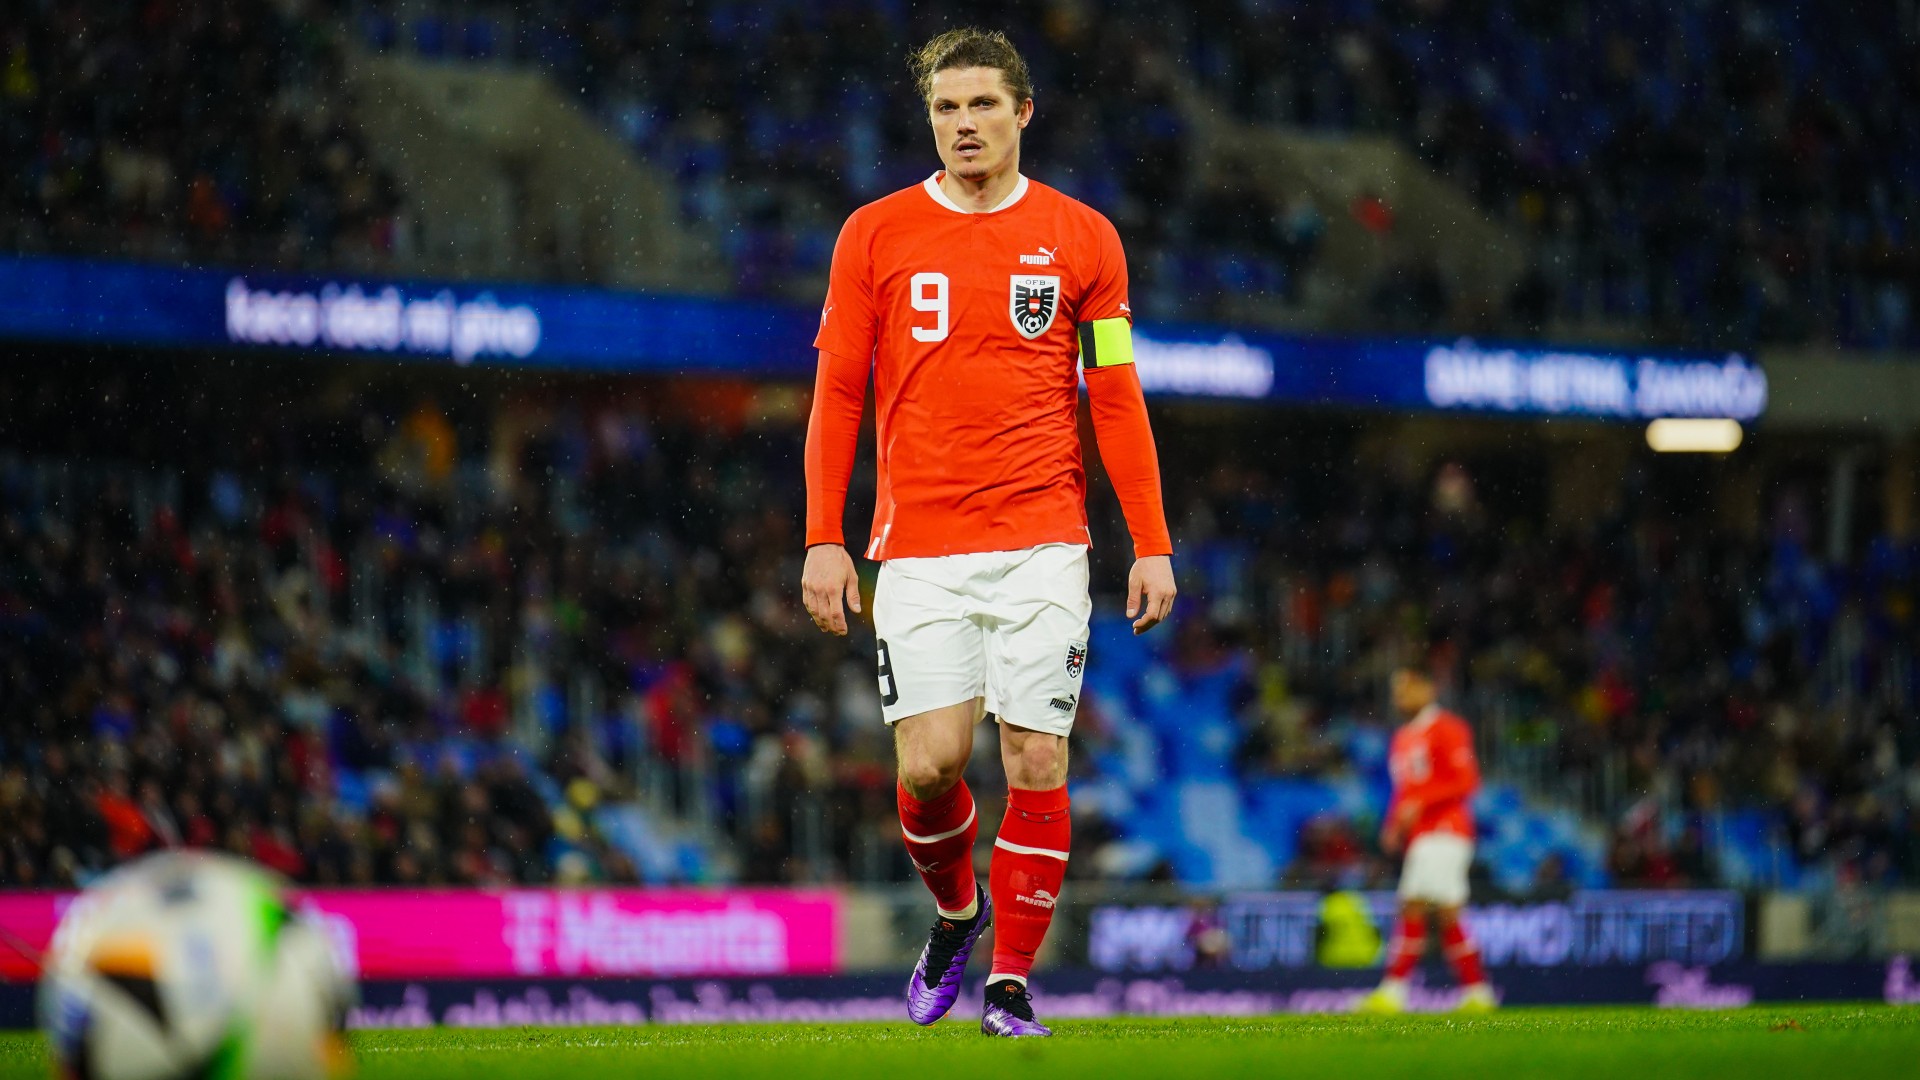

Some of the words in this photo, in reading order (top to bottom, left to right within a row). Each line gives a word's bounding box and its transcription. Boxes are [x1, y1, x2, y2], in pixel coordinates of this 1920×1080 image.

[1019, 254, 1050, 265] PUMA
[910, 272, 949, 342] 9
[1050, 697, 1074, 712] PUMA
